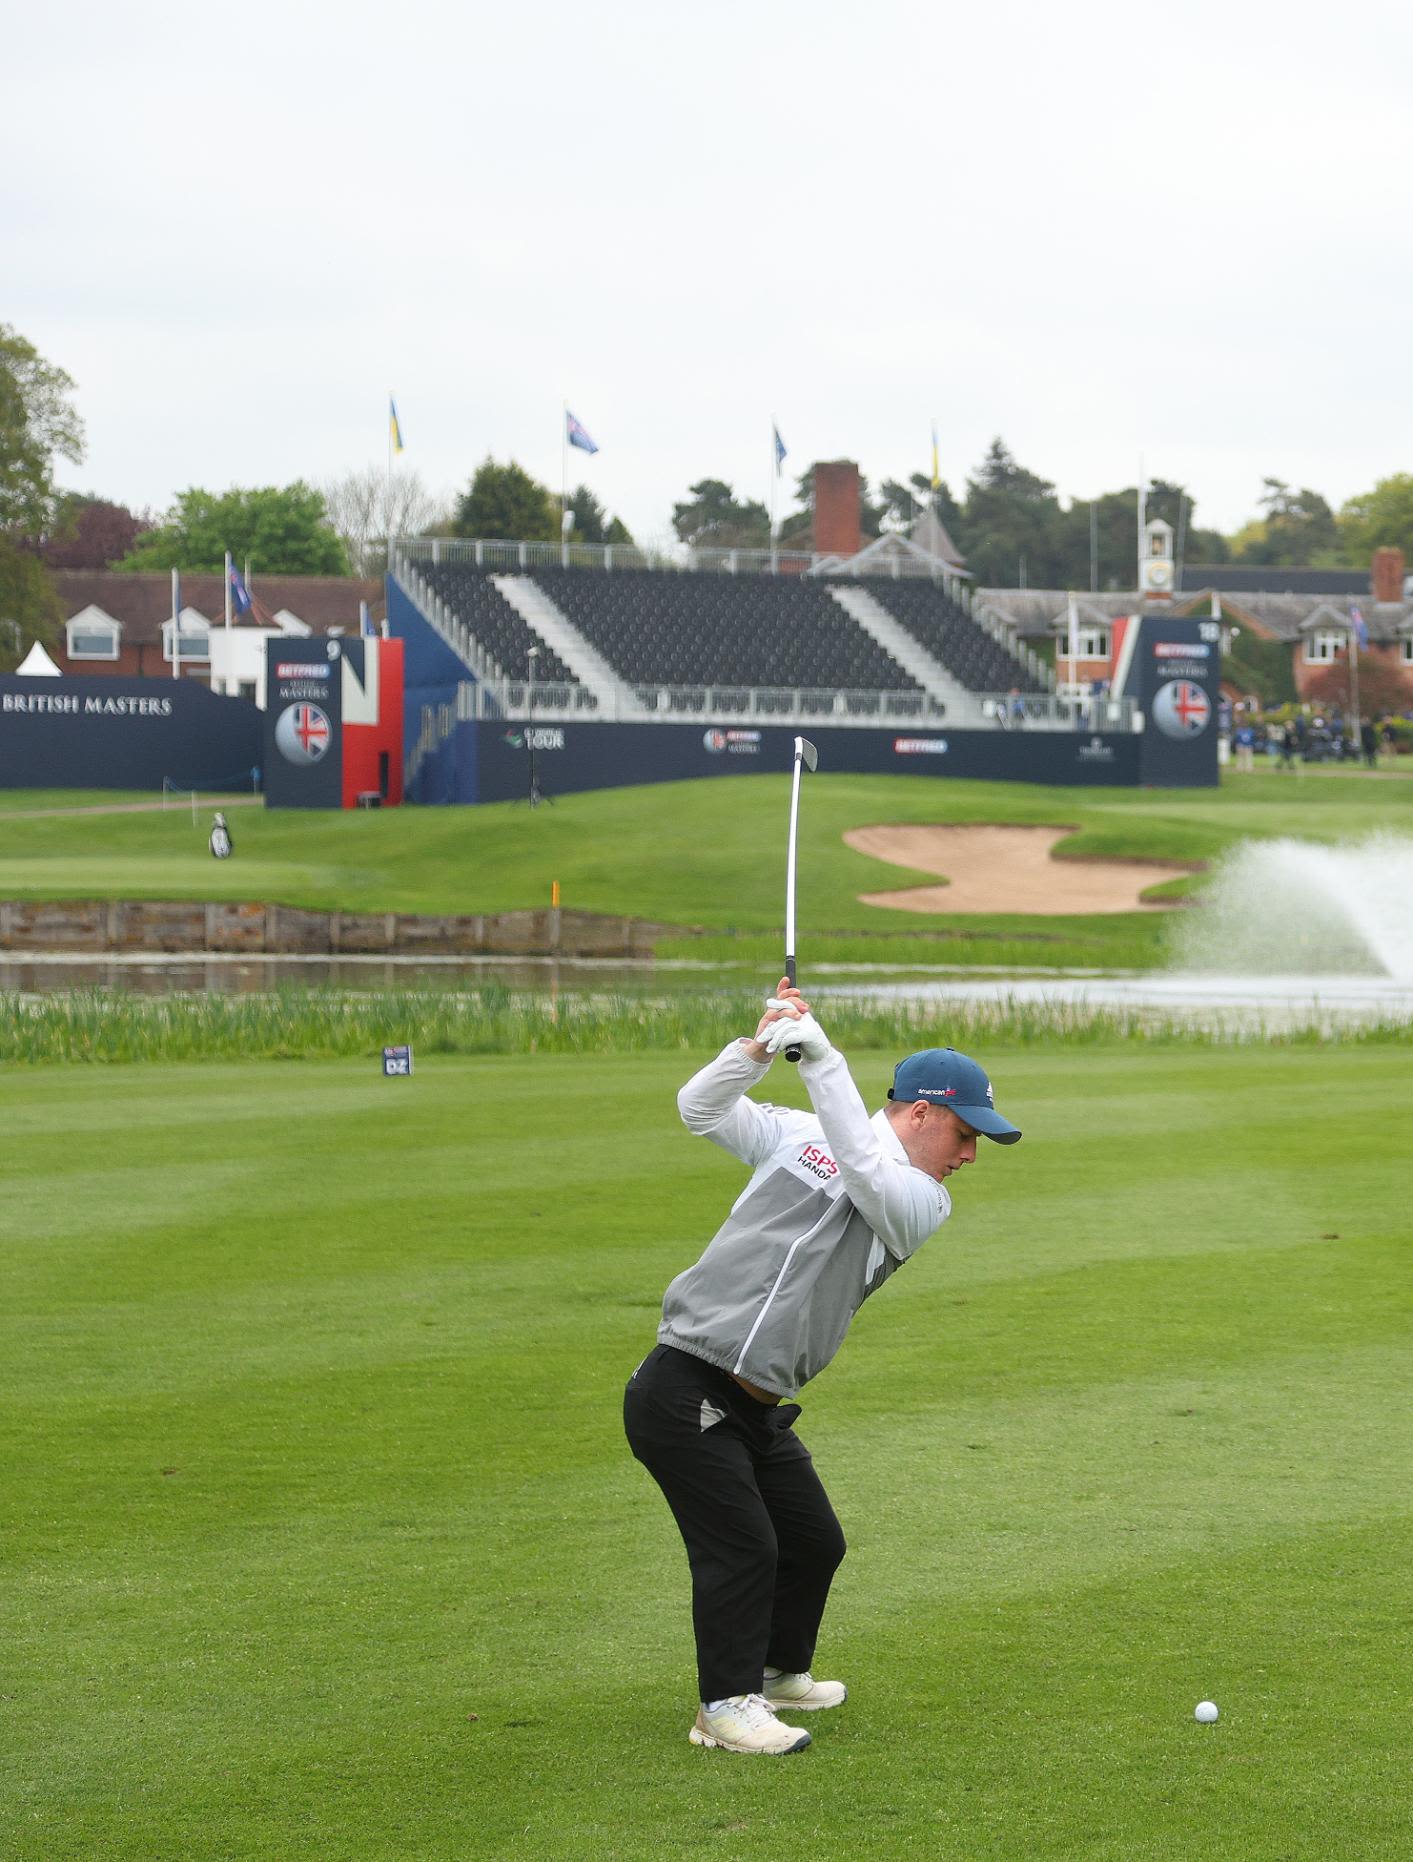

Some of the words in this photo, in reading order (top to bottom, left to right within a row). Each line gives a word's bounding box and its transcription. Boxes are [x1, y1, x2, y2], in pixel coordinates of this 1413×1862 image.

[1198, 622, 1219, 641] 18
[326, 639, 341, 661] 9
[2, 693, 79, 713] BRITISH
[84, 696, 172, 717] MASTERS
[802, 1145, 838, 1175] ISPS
